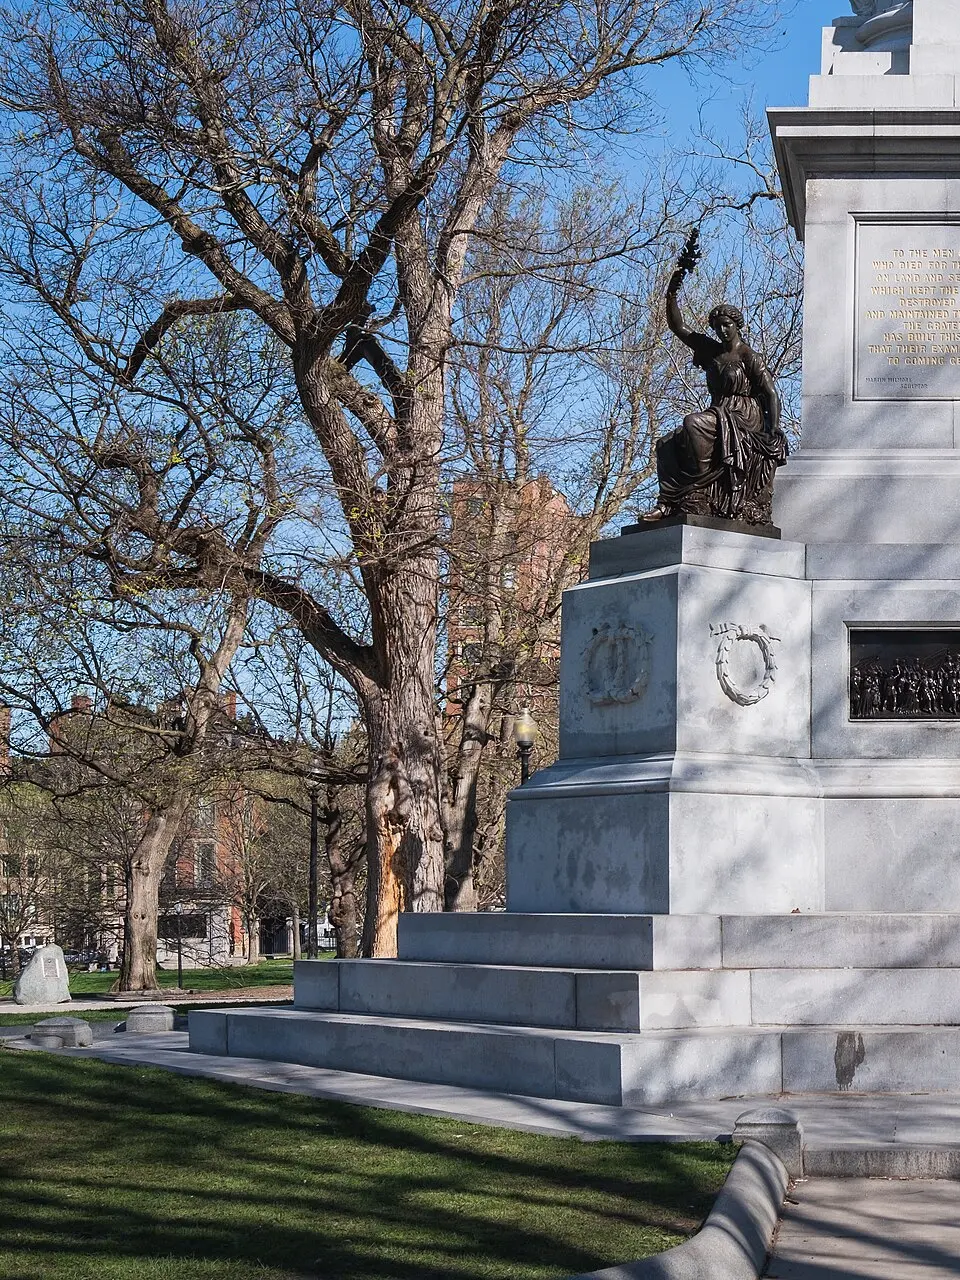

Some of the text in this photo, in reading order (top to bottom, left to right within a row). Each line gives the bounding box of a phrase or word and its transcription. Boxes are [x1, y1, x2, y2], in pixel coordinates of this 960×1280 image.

[893, 249, 904, 257] TO
[909, 249, 927, 257] THE
[933, 249, 954, 257] MEN
[873, 261, 894, 269] WHO
[900, 261, 922, 269] DIED
[929, 261, 947, 269] FOR
[876, 274, 889, 282] ON
[895, 274, 920, 282] LAND
[924, 274, 943, 282] AND
[871, 286, 904, 294] WHICH
[910, 286, 936, 294] KEPT
[940, 286, 958, 294] THE
[900, 298, 955, 306] DESTROYED
[866, 310, 885, 318] AND
[890, 310, 949, 318] MAINTAINED
[903, 321, 921, 330] THE
[884, 333, 903, 341] HAS
[908, 333, 936, 341] BUILT
[940, 333, 960, 341] THIS
[868, 344, 892, 353] THAT
[897, 344, 927, 353] THEIR
[887, 356, 899, 365] TO
[905, 356, 944, 365] COMING
